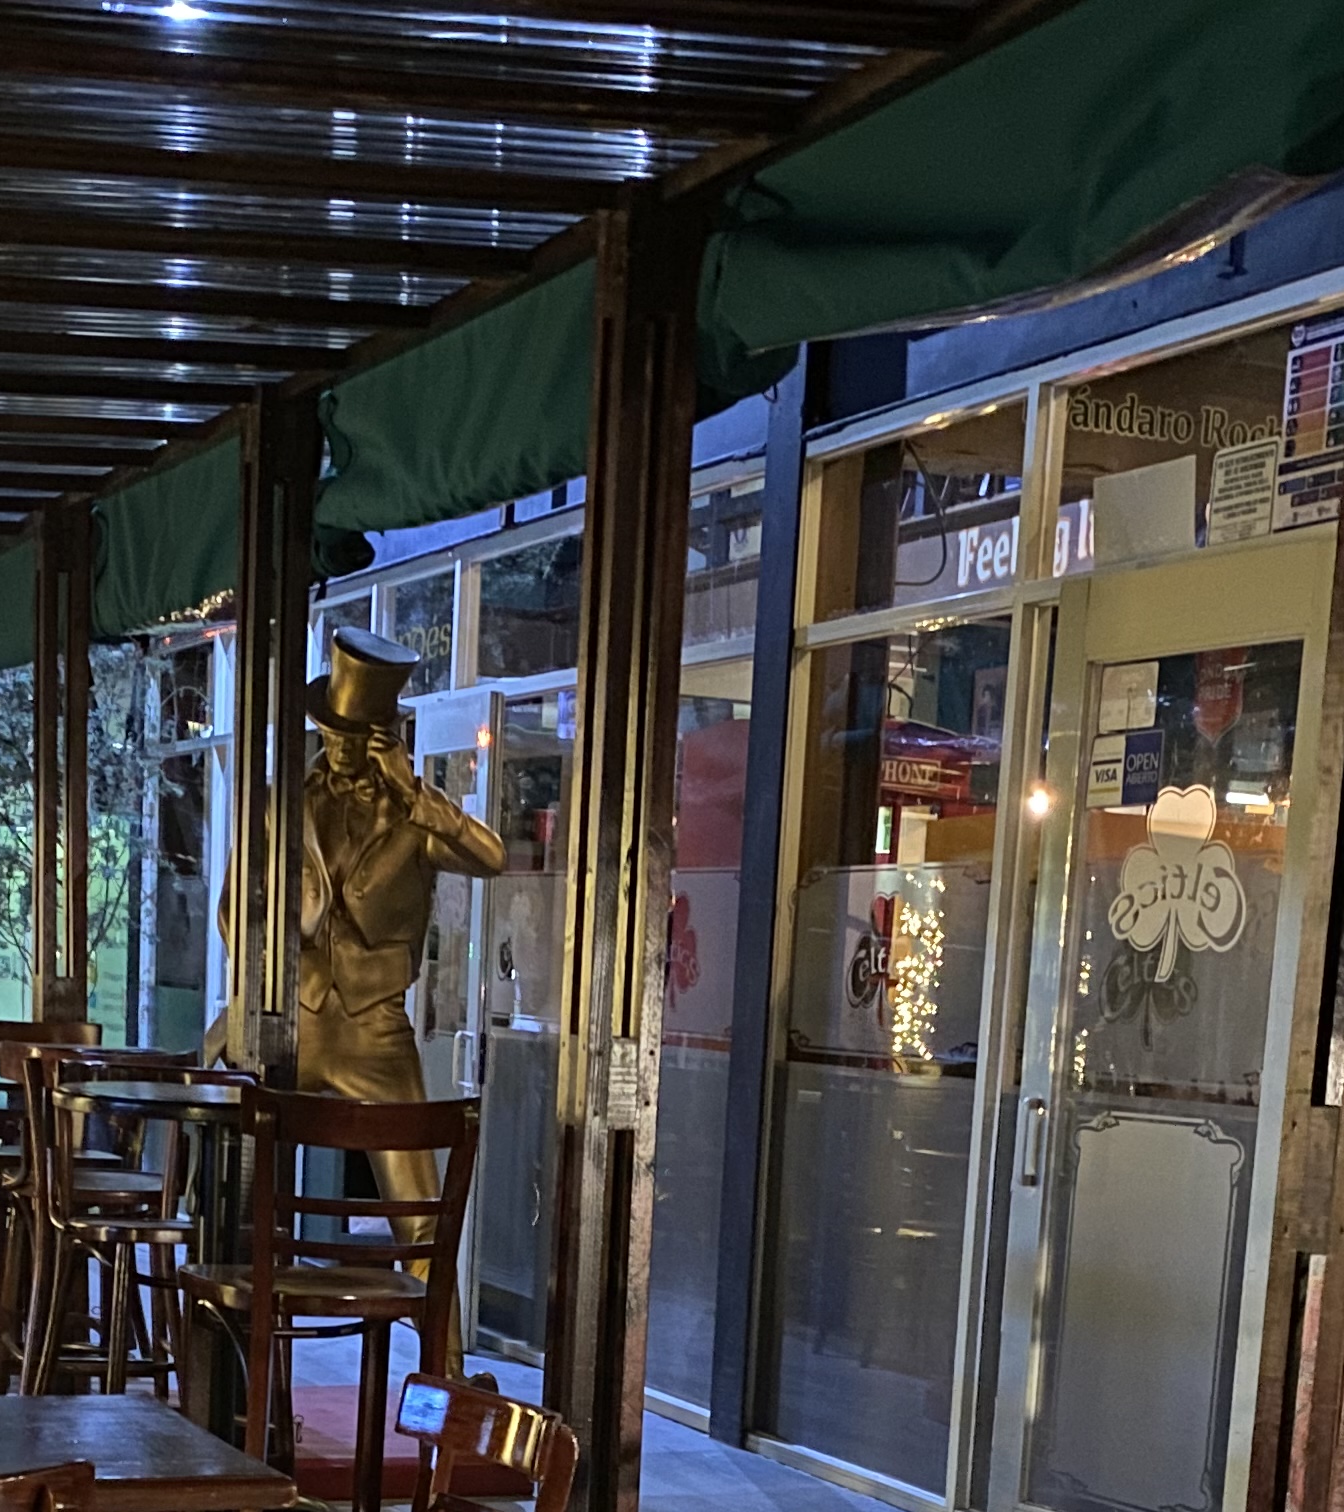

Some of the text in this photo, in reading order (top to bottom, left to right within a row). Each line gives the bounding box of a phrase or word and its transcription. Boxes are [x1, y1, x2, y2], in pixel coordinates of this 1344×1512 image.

[1067, 384, 1194, 444] ándaro
[957, 516, 1071, 587] Feelg
[881, 760, 937, 785] HONE
[1126, 752, 1159, 772] OPEN
[1094, 768, 1118, 783] VISA
